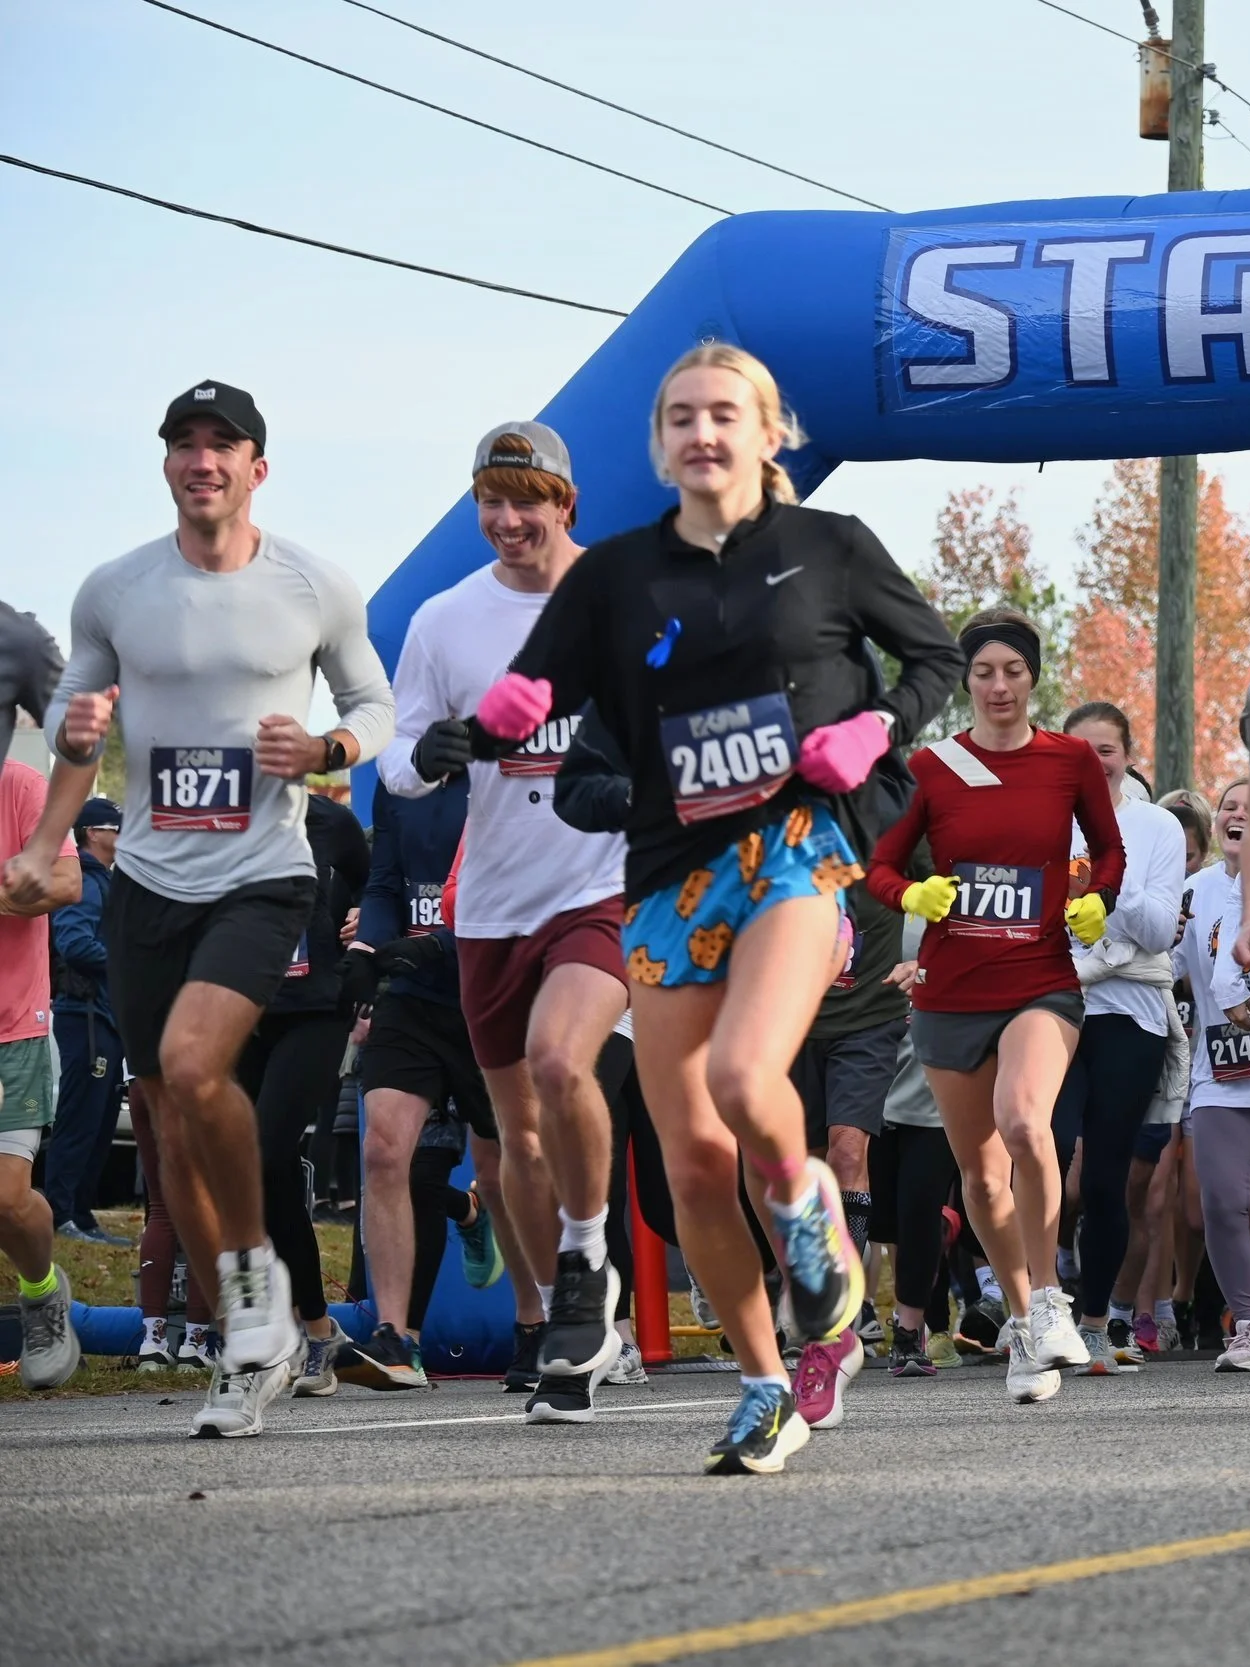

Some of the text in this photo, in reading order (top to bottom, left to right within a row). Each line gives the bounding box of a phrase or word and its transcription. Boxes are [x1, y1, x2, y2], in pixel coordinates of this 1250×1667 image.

[671, 724, 791, 796] 2405
[157, 768, 240, 807] 1871
[410, 897, 446, 926] 192
[957, 882, 1032, 920] 1701
